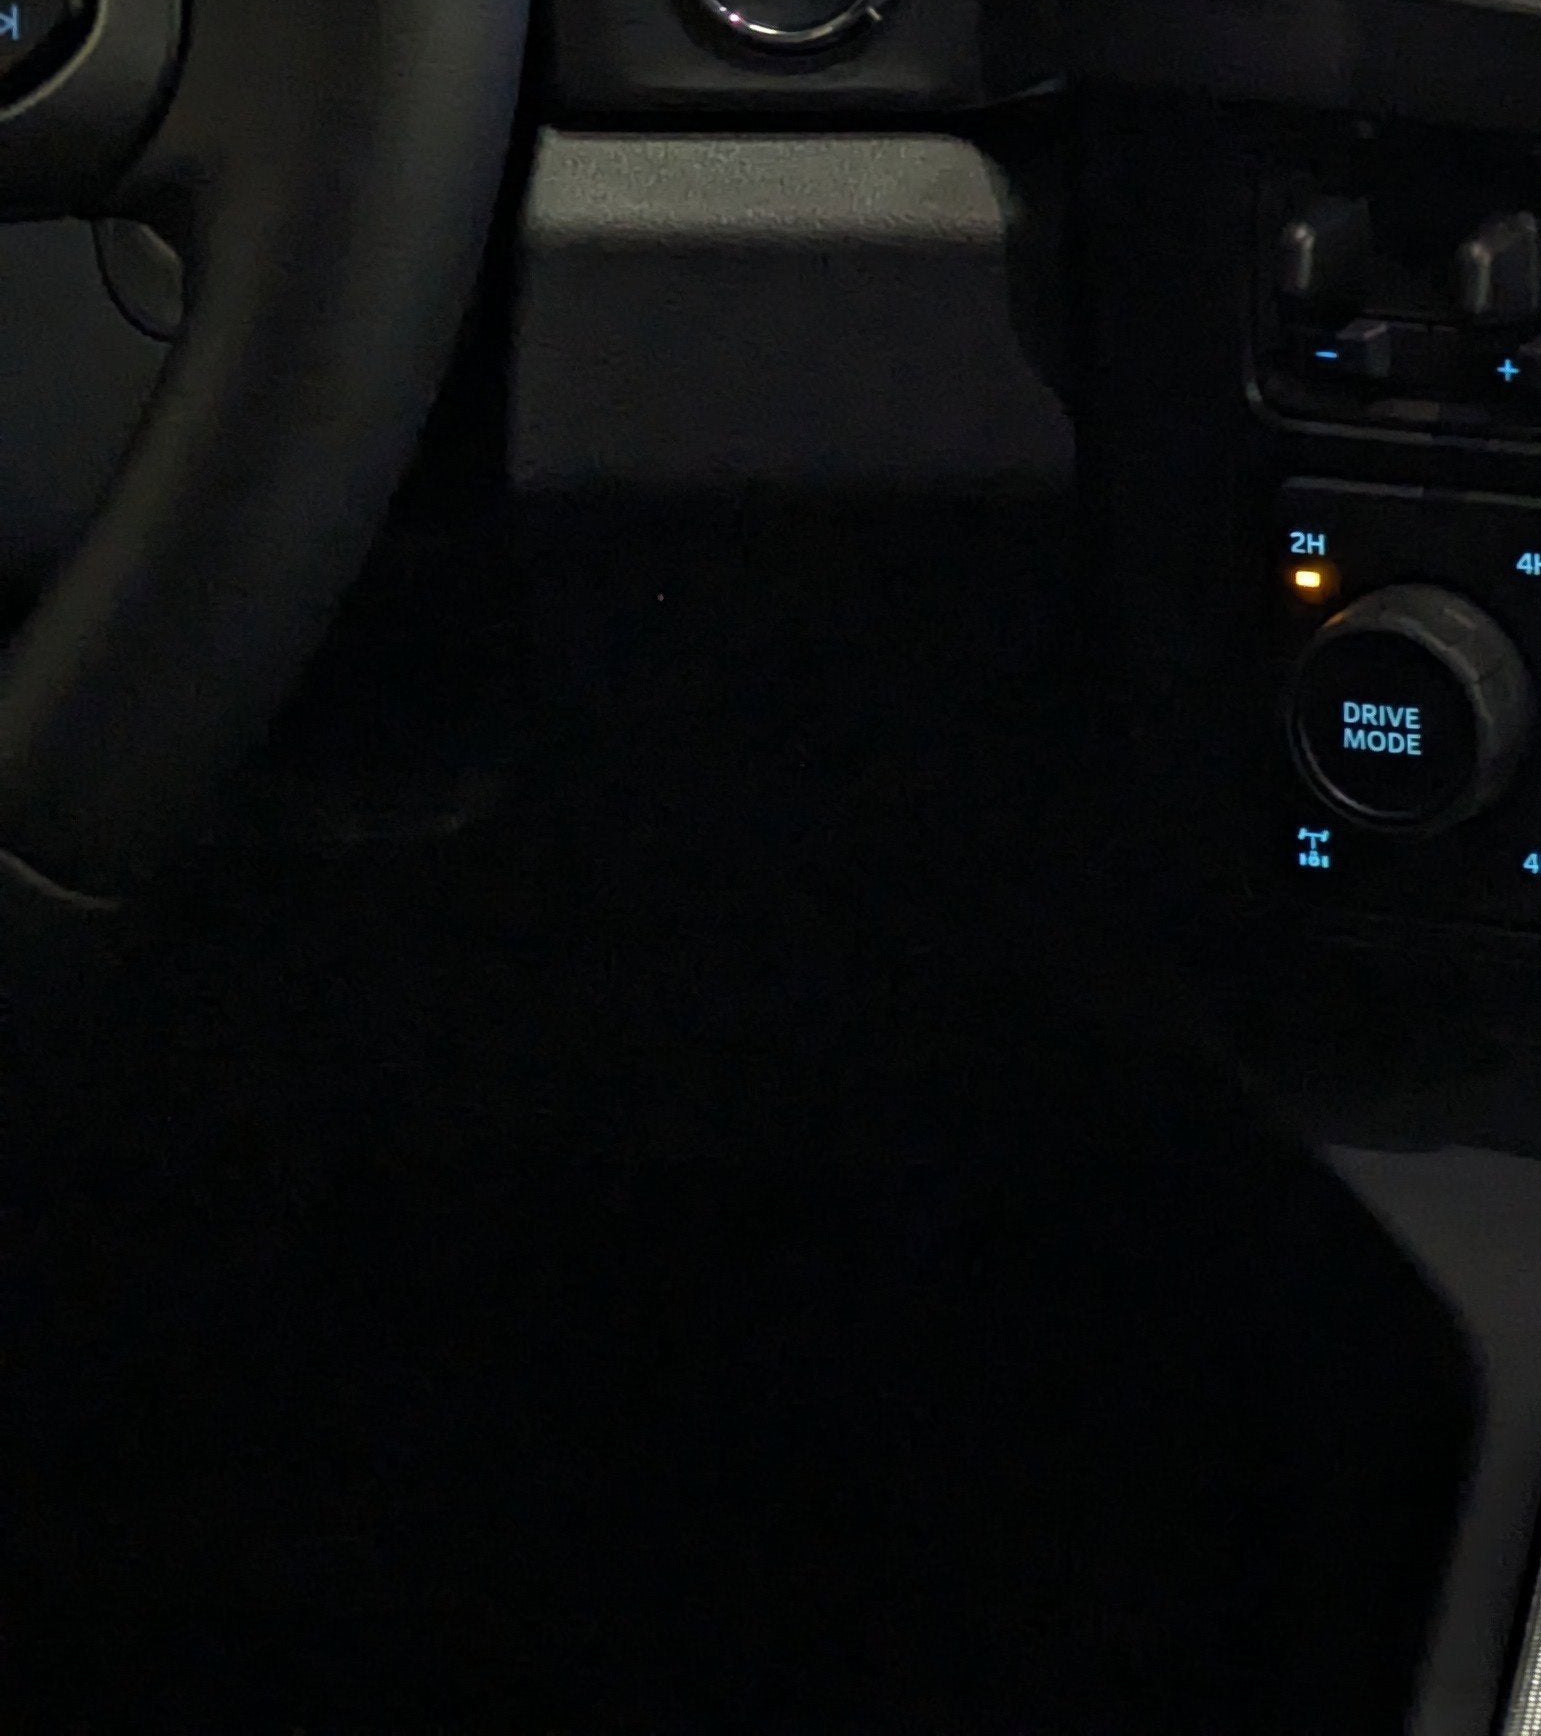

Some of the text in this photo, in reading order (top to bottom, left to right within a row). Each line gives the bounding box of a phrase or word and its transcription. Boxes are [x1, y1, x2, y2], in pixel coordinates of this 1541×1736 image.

[1289, 530, 1325, 556] 2H
[1343, 700, 1421, 730] DRIVE
[1343, 728, 1422, 756] MODE
